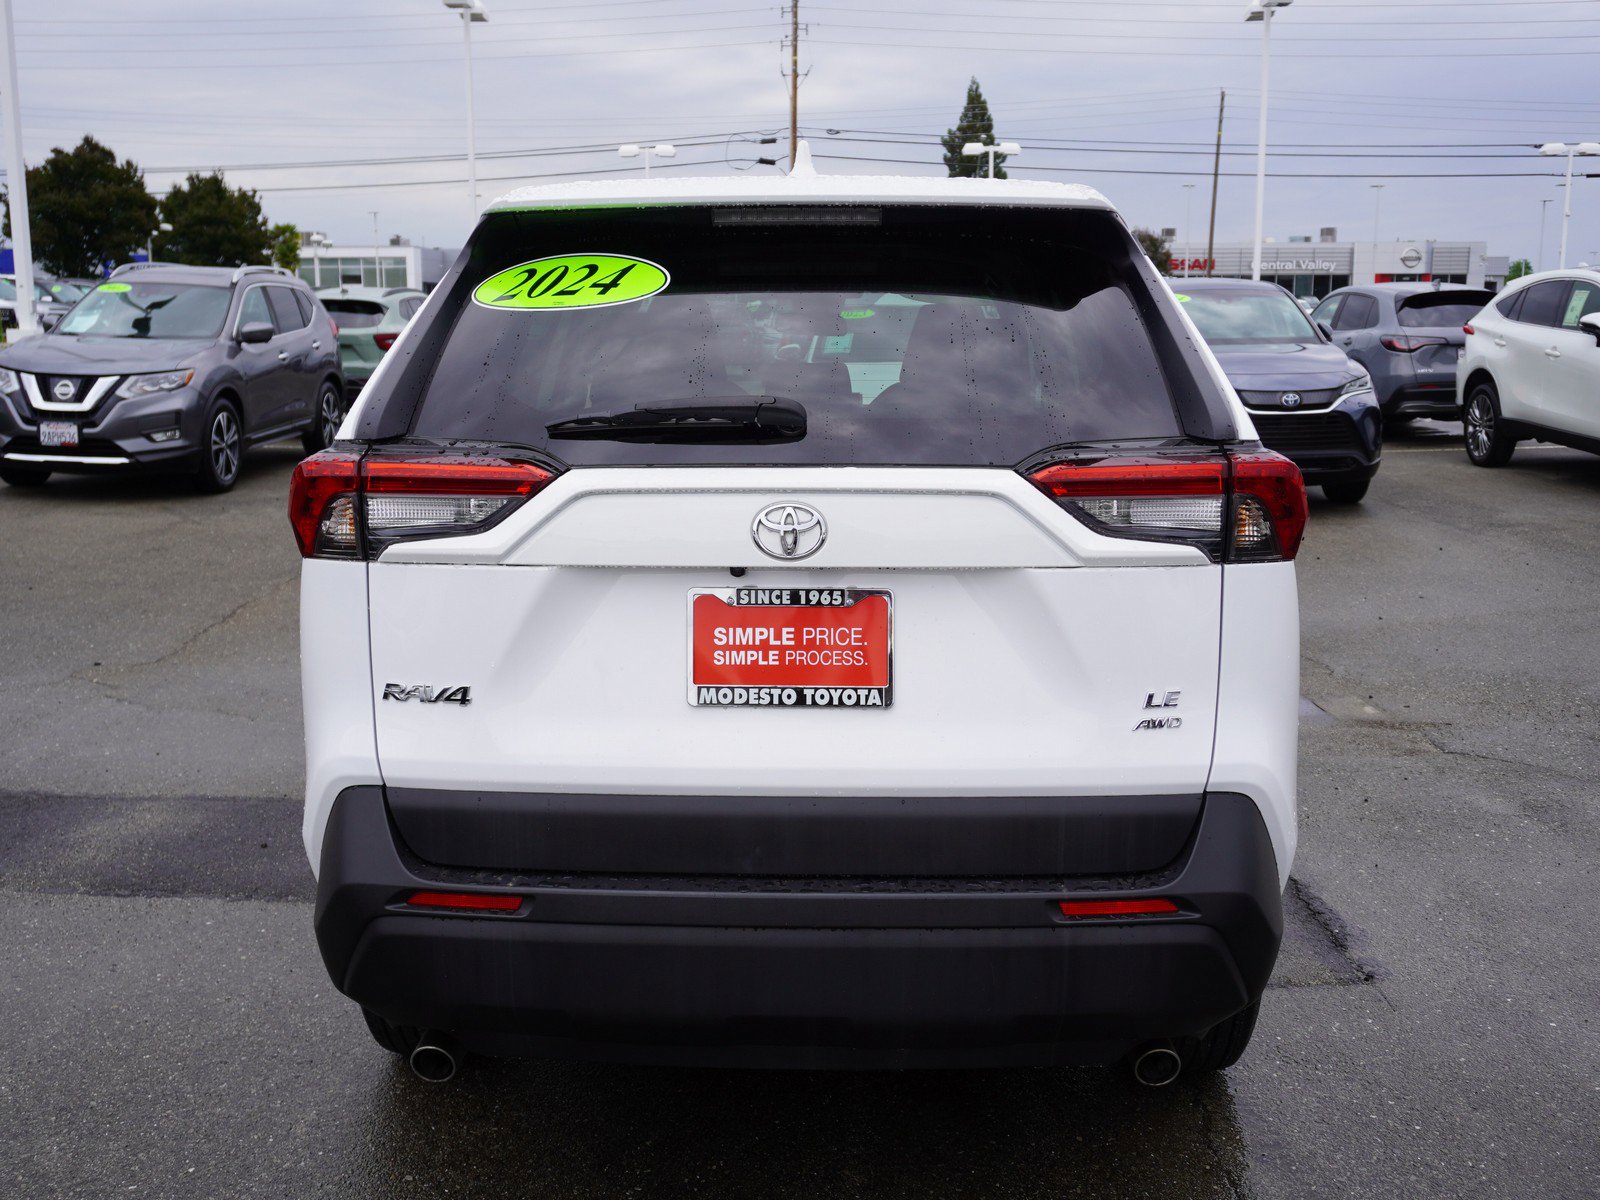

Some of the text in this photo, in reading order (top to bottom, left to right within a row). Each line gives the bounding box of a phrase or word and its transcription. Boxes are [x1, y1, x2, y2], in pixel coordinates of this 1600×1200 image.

[1300, 260, 1336, 271] Valley
[491, 263, 638, 302] 2024
[739, 590, 843, 605] SINCE 1965
[713, 627, 868, 646] SIMPLE PRICE.
[713, 650, 868, 665] SIMPLE PROCESS.
[383, 683, 471, 705] RAV4
[700, 687, 882, 705] MODESTO TOYOTA
[1143, 690, 1180, 709] LE
[1132, 717, 1182, 731] AWD
